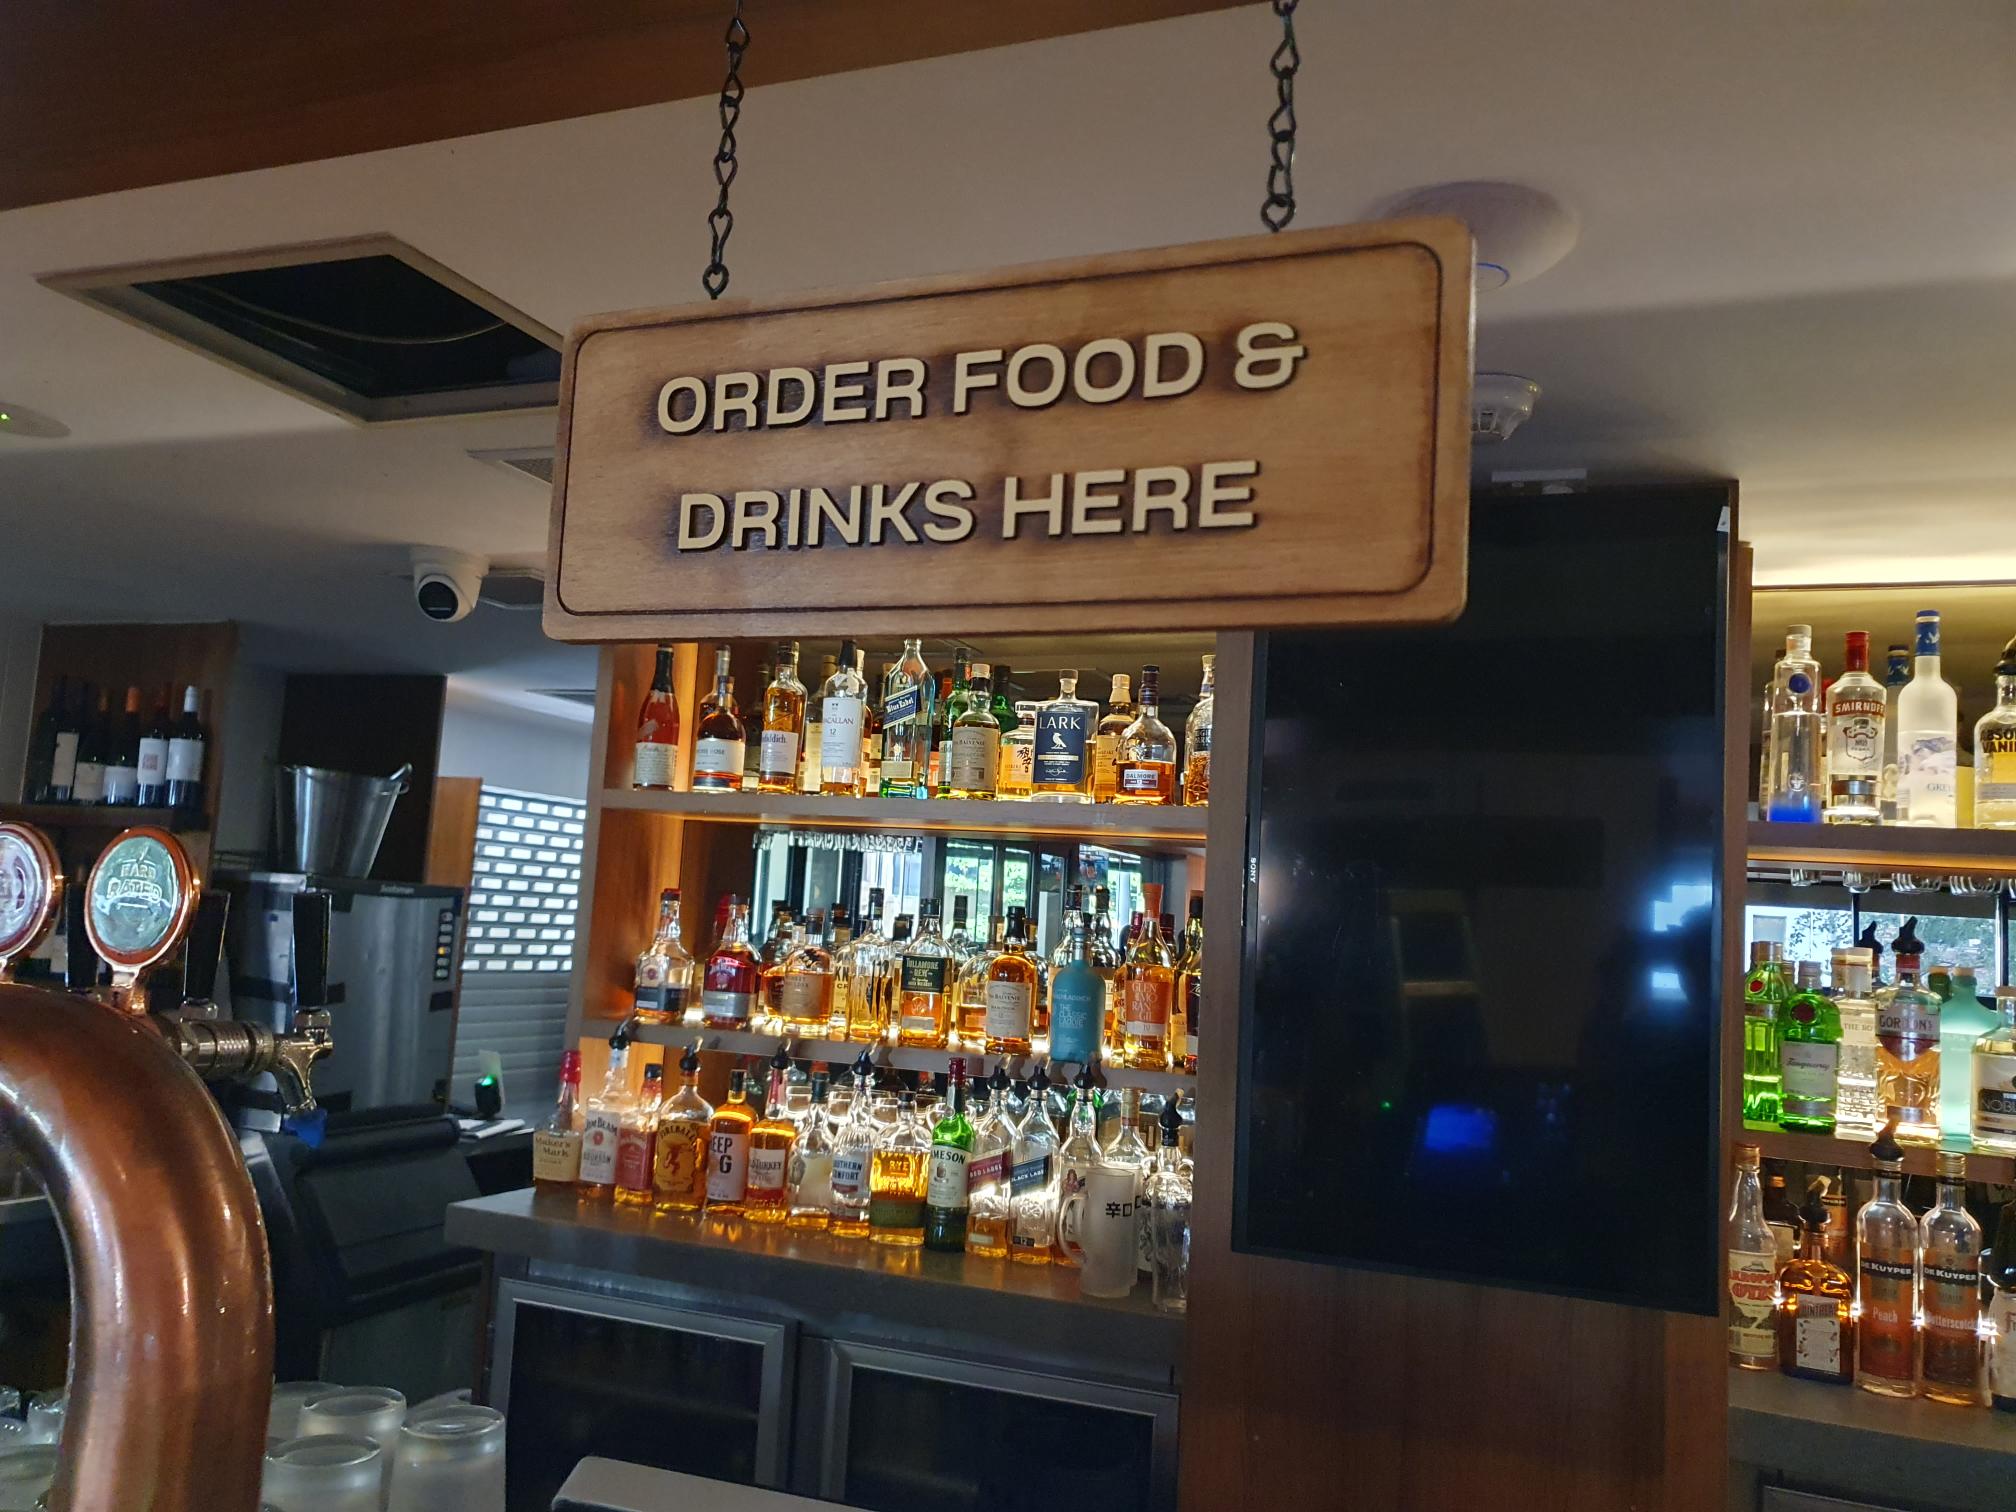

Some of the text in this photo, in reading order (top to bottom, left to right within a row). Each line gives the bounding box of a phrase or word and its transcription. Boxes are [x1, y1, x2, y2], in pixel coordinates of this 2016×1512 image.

[656, 321, 1307, 437] ORDER FOOD &
[676, 459, 1260, 552] DRINKS HERE
[1834, 702, 1885, 712] SMIRNOFF
[1039, 715, 1081, 730] LARK
[1125, 772, 1157, 780] DALMORE
[120, 862, 157, 878] HARD
[1249, 857, 1257, 884] SONY
[106, 877, 163, 904] RATED
[906, 957, 939, 970] TULLAMORE
[1131, 982, 1158, 993] GLEN
[1786, 1057, 1831, 1072] Tanqueray
[535, 1136, 571, 1148] Maker's
[543, 1146, 569, 1158] Mark
[889, 1160, 910, 1172] RYE
[1105, 1201, 1133, 1219] 辛口
[1871, 1262, 1912, 1275] KUYPER
[1924, 1266, 1977, 1281] DE KUYPER
[1872, 1305, 1898, 1324] Peach
